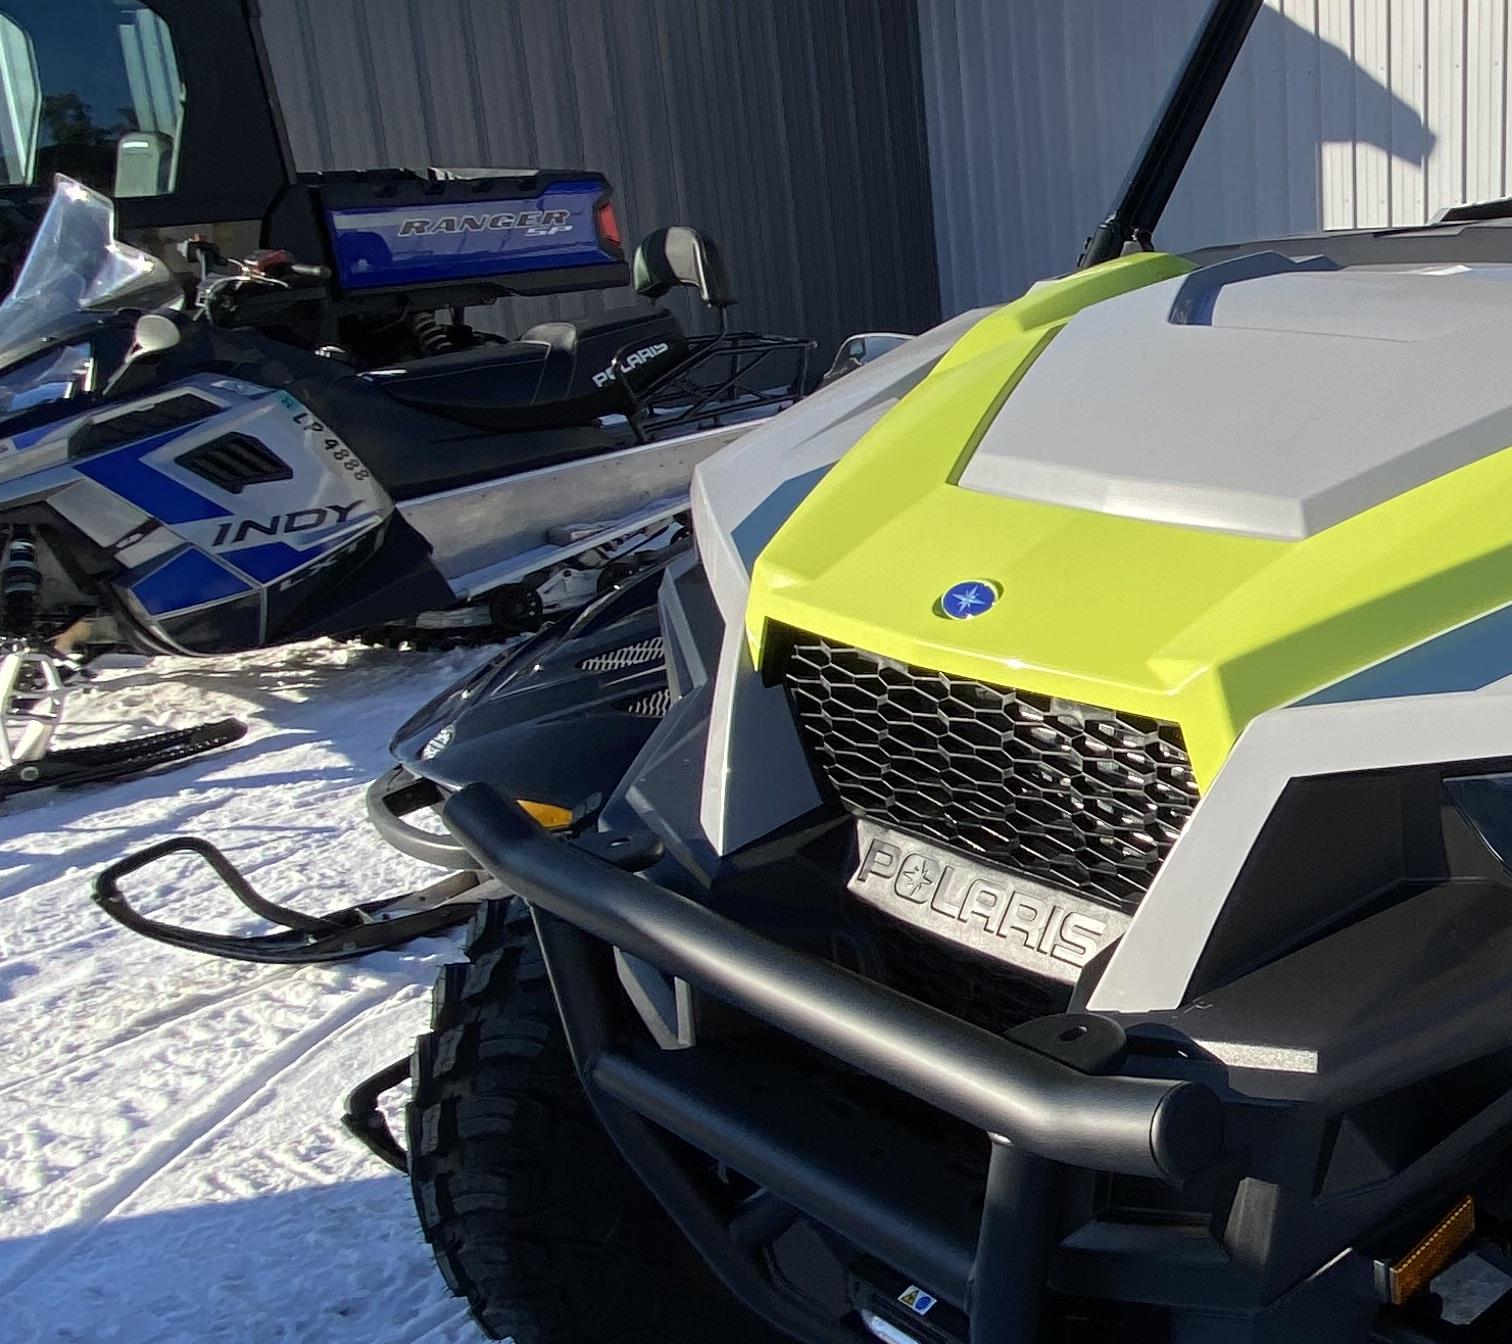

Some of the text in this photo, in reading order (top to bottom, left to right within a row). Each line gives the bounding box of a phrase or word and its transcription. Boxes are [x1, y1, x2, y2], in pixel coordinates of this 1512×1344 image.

[398, 210, 570, 237] RANGER
[525, 225, 573, 237] SP
[324, 438, 369, 481] 4888
[213, 500, 366, 547] INDY
[858, 838, 1107, 968] POLARIS
